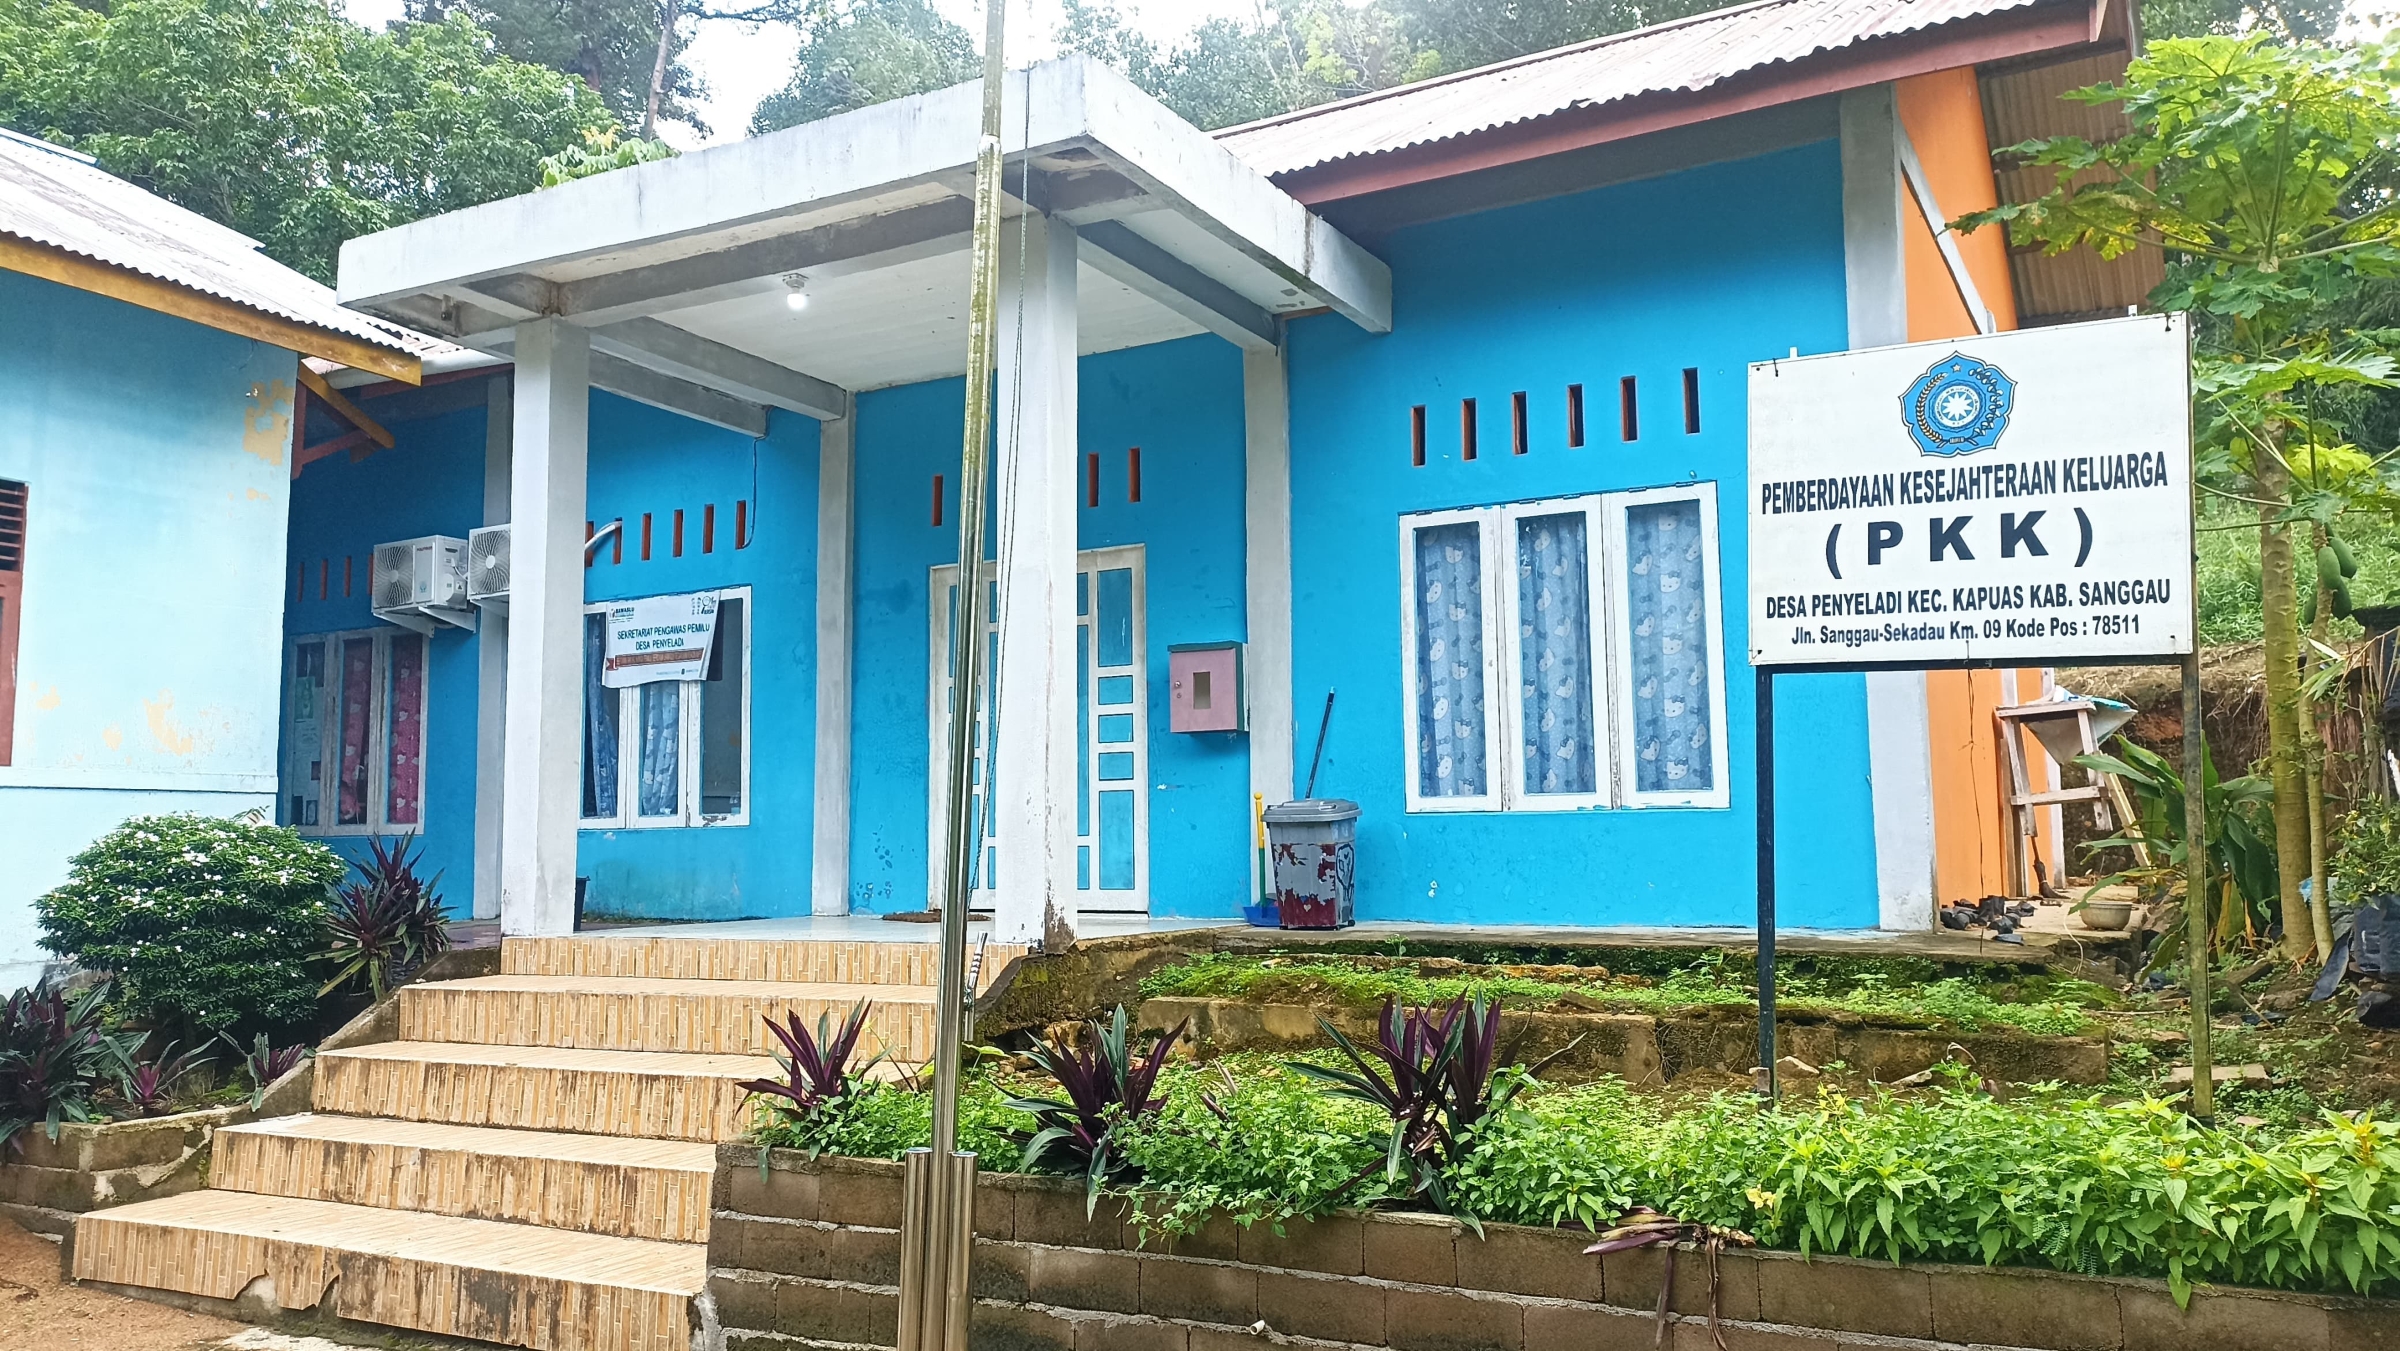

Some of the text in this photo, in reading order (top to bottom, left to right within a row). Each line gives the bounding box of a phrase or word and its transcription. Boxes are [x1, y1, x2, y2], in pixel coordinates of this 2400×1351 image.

[1762, 451, 2168, 514] PEMBERDAYAAN KESEJAHTERAAN KELUARGA
[1766, 578, 2171, 619] DESA PENYELADI KEC. KAPUAS KAB. SANGGAU
[617, 623, 710, 640] SEKRETARIAT PENGAWAS PEMILU
[635, 637, 684, 651] DESA PENYELADI
[1791, 626, 1816, 645] Jln.
[1820, 622, 1945, 648] Sanggau-Sekadau
[1950, 620, 1979, 639] Km.
[1983, 619, 2002, 638] 09
[2006, 618, 2045, 638] Kode
[2050, 617, 2078, 636] Pos
[2092, 614, 2140, 635] 78511
